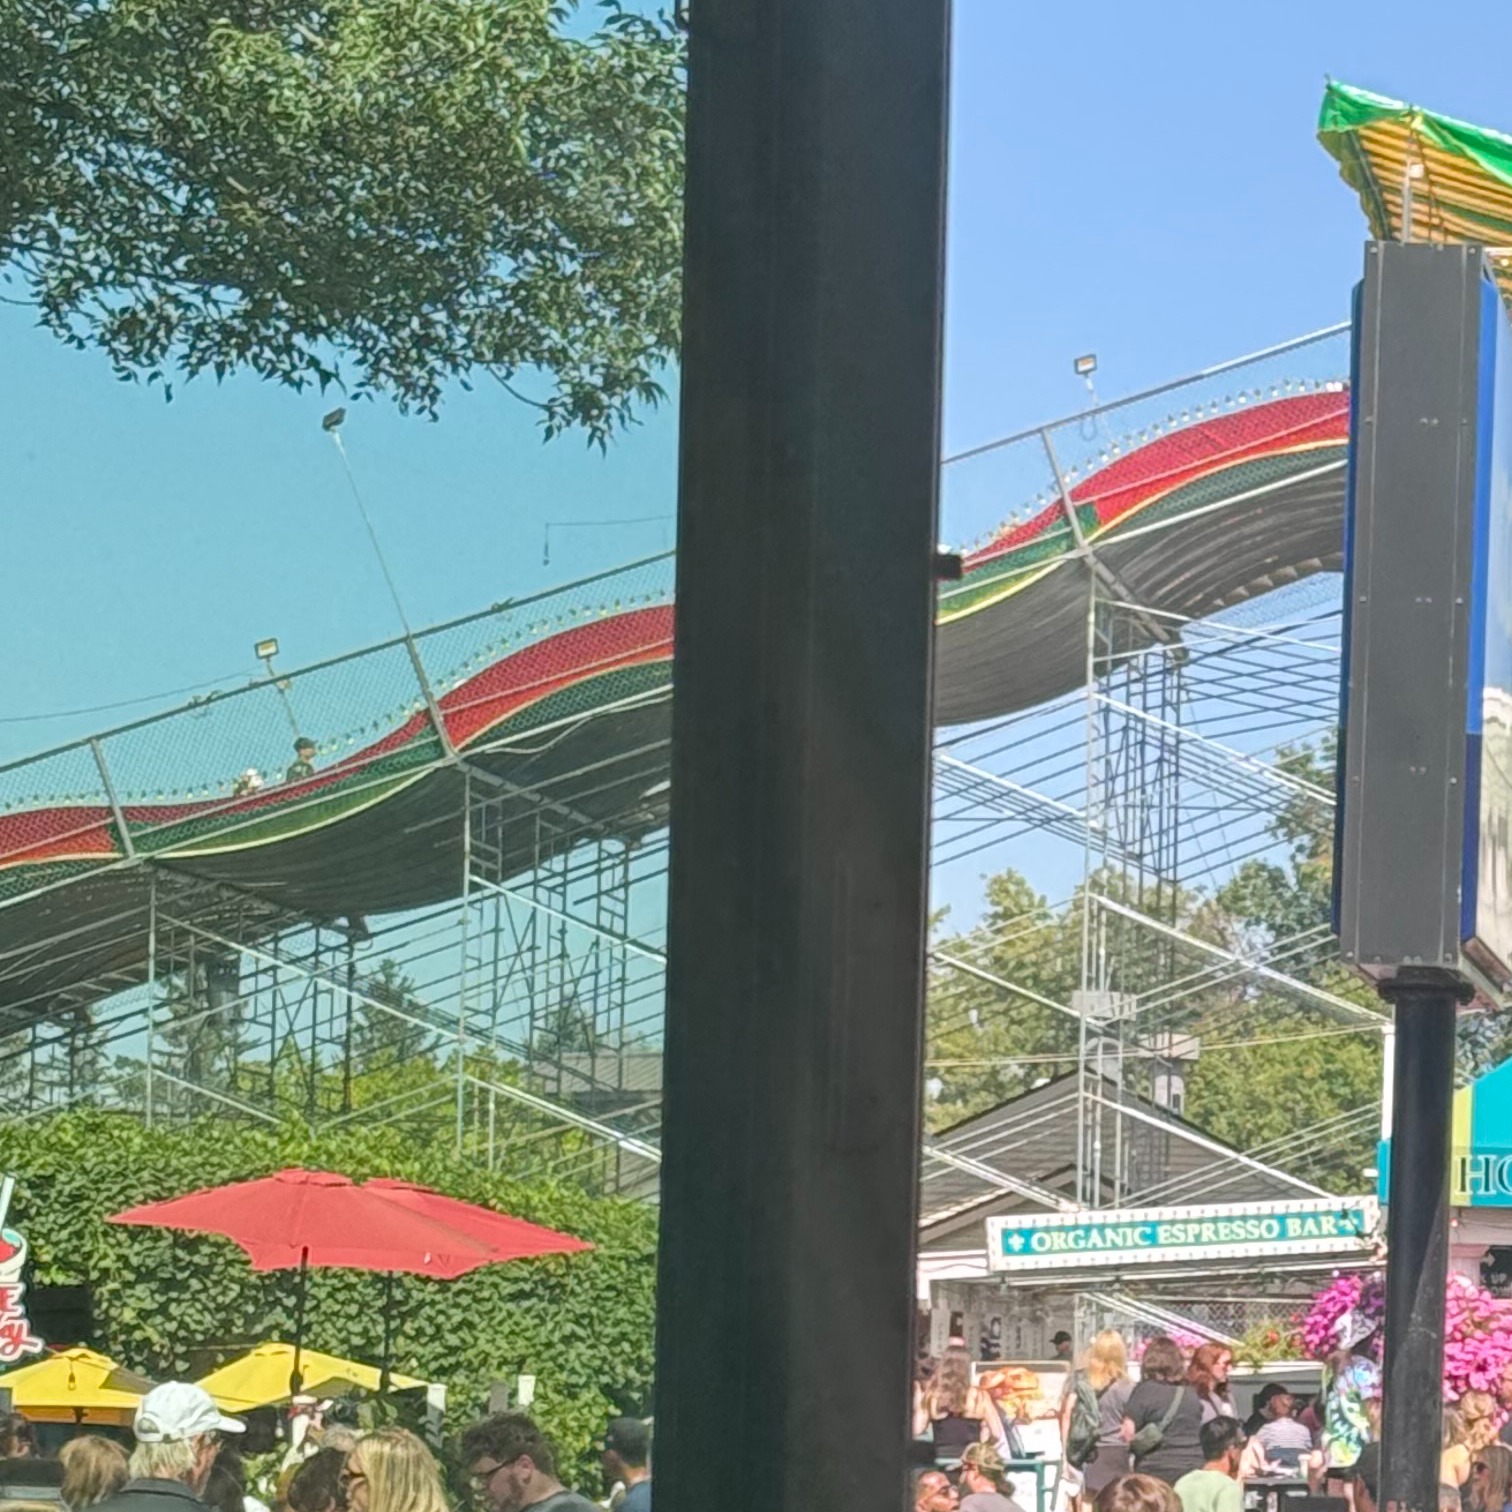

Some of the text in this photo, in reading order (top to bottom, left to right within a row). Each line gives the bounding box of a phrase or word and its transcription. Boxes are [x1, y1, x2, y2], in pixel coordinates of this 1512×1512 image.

[1030, 1213, 1338, 1253] ORGANIC ESPRESSO BAR
